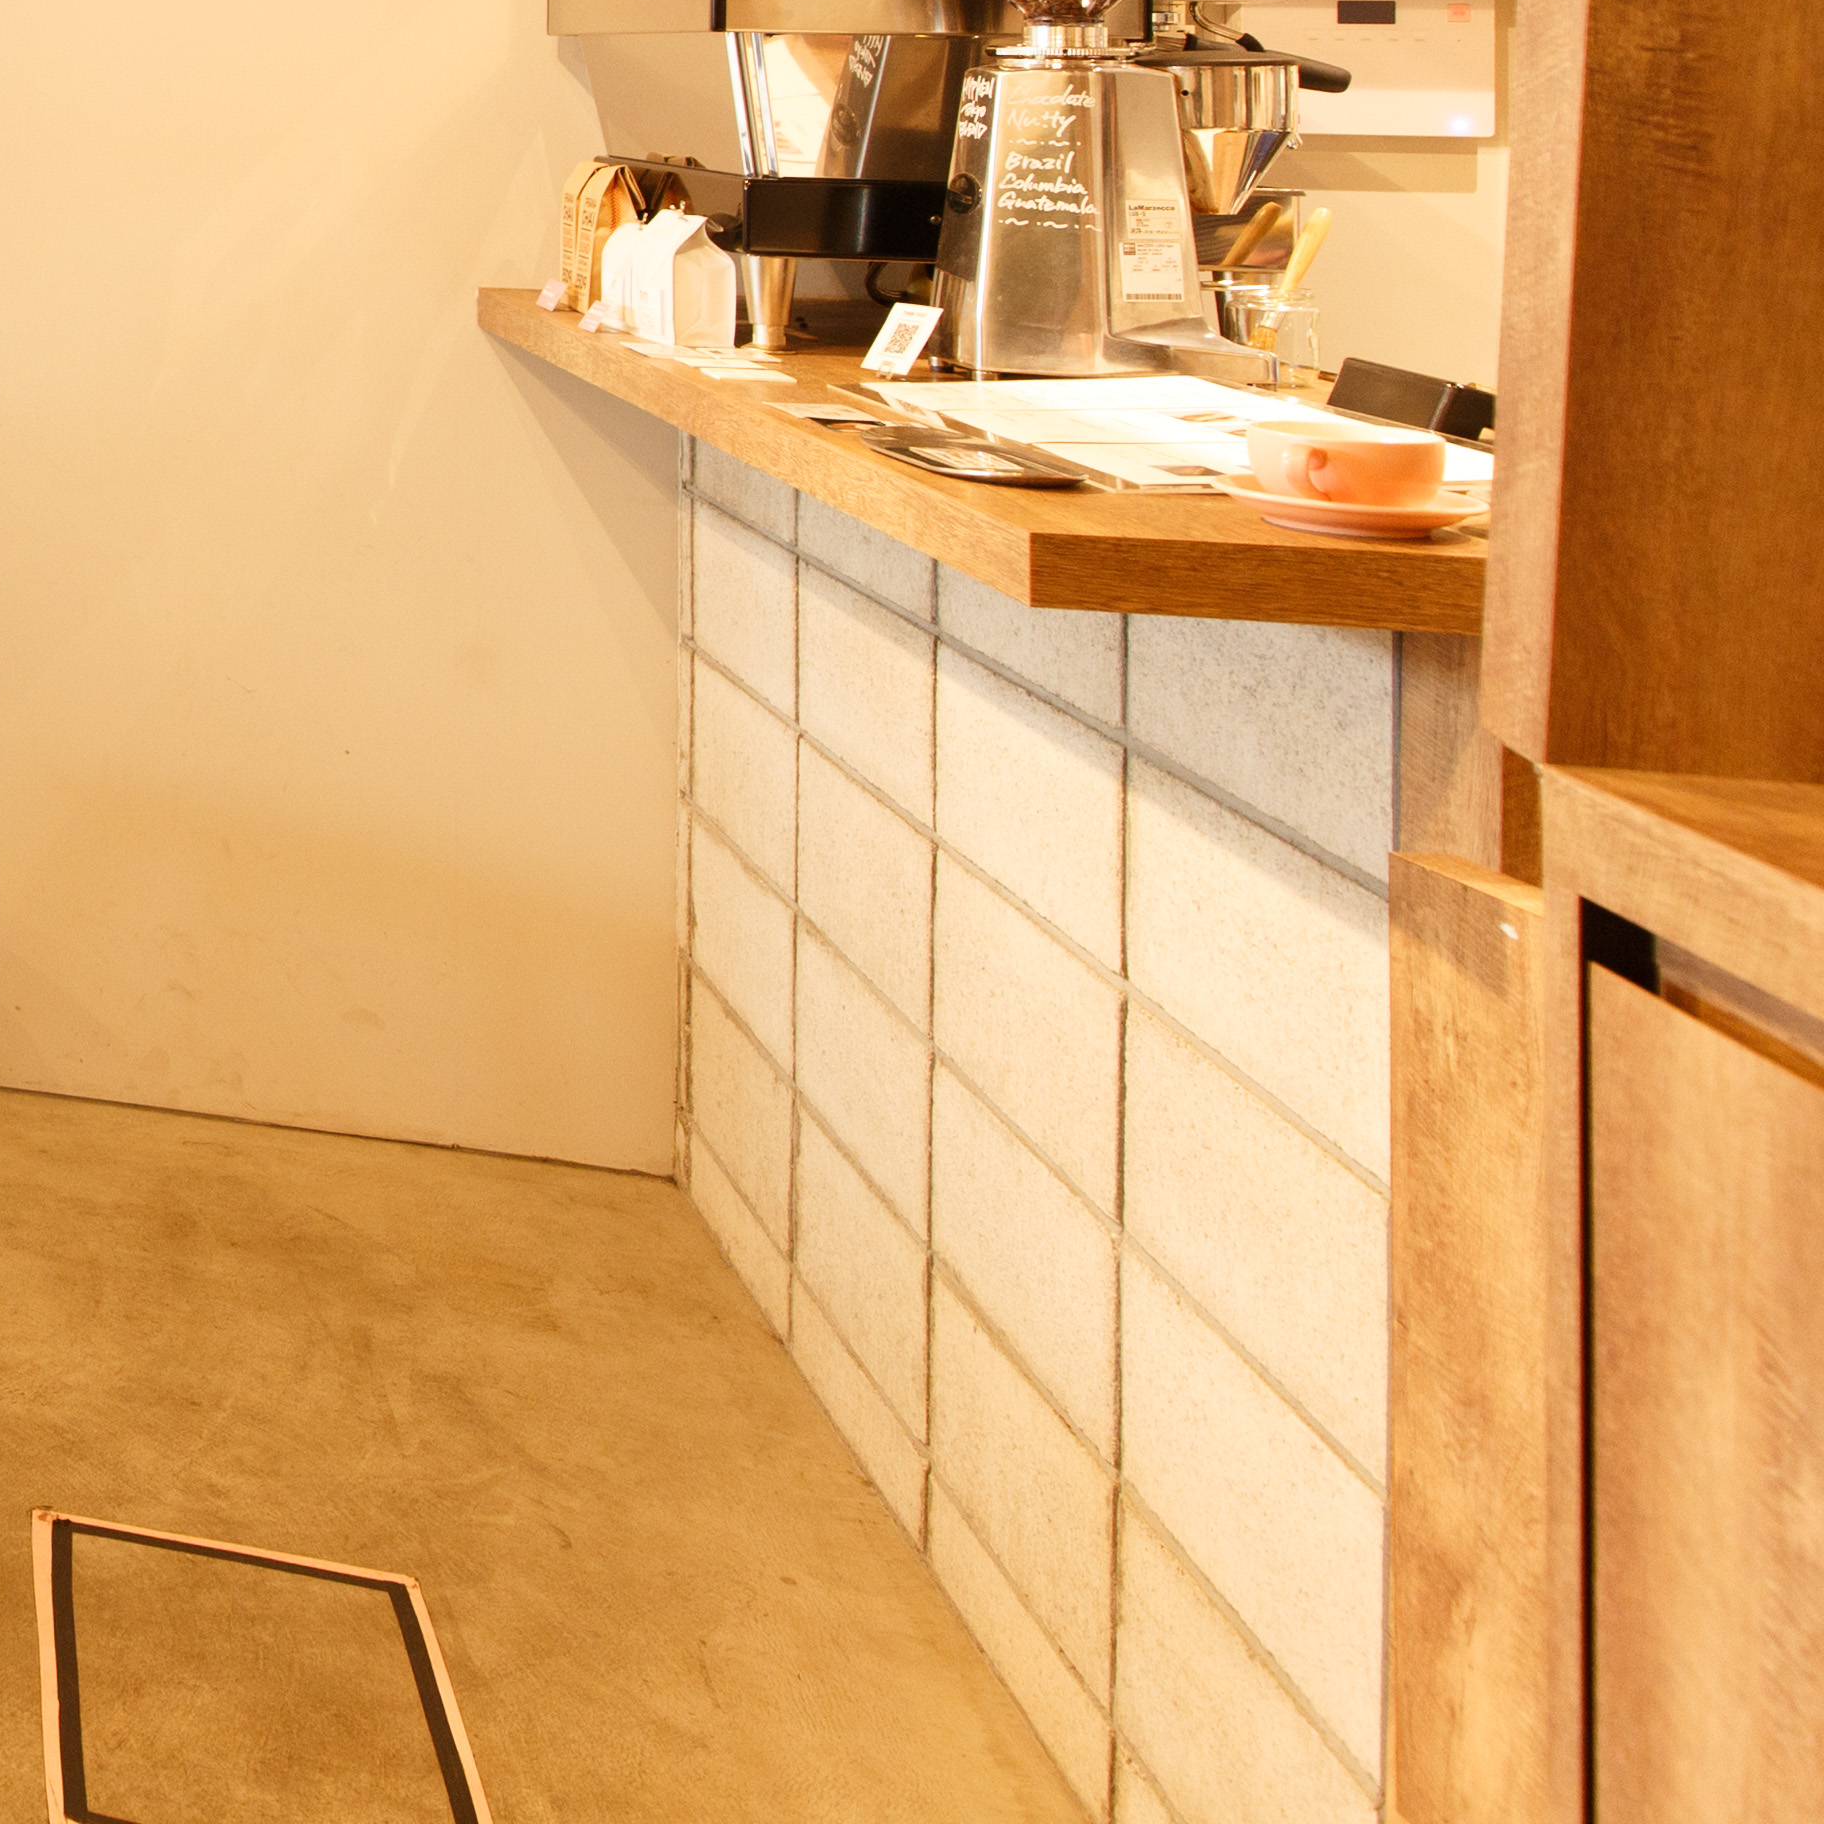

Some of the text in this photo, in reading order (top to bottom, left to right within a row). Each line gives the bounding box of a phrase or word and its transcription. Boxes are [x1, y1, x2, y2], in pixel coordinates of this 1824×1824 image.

[1007, 84, 1096, 108] Chocolate
[1007, 108, 1077, 138] Nutty
[1004, 150, 1075, 174] Brazil
[998, 172, 1088, 194] Columbia
[997, 190, 1101, 214] Guatemala
